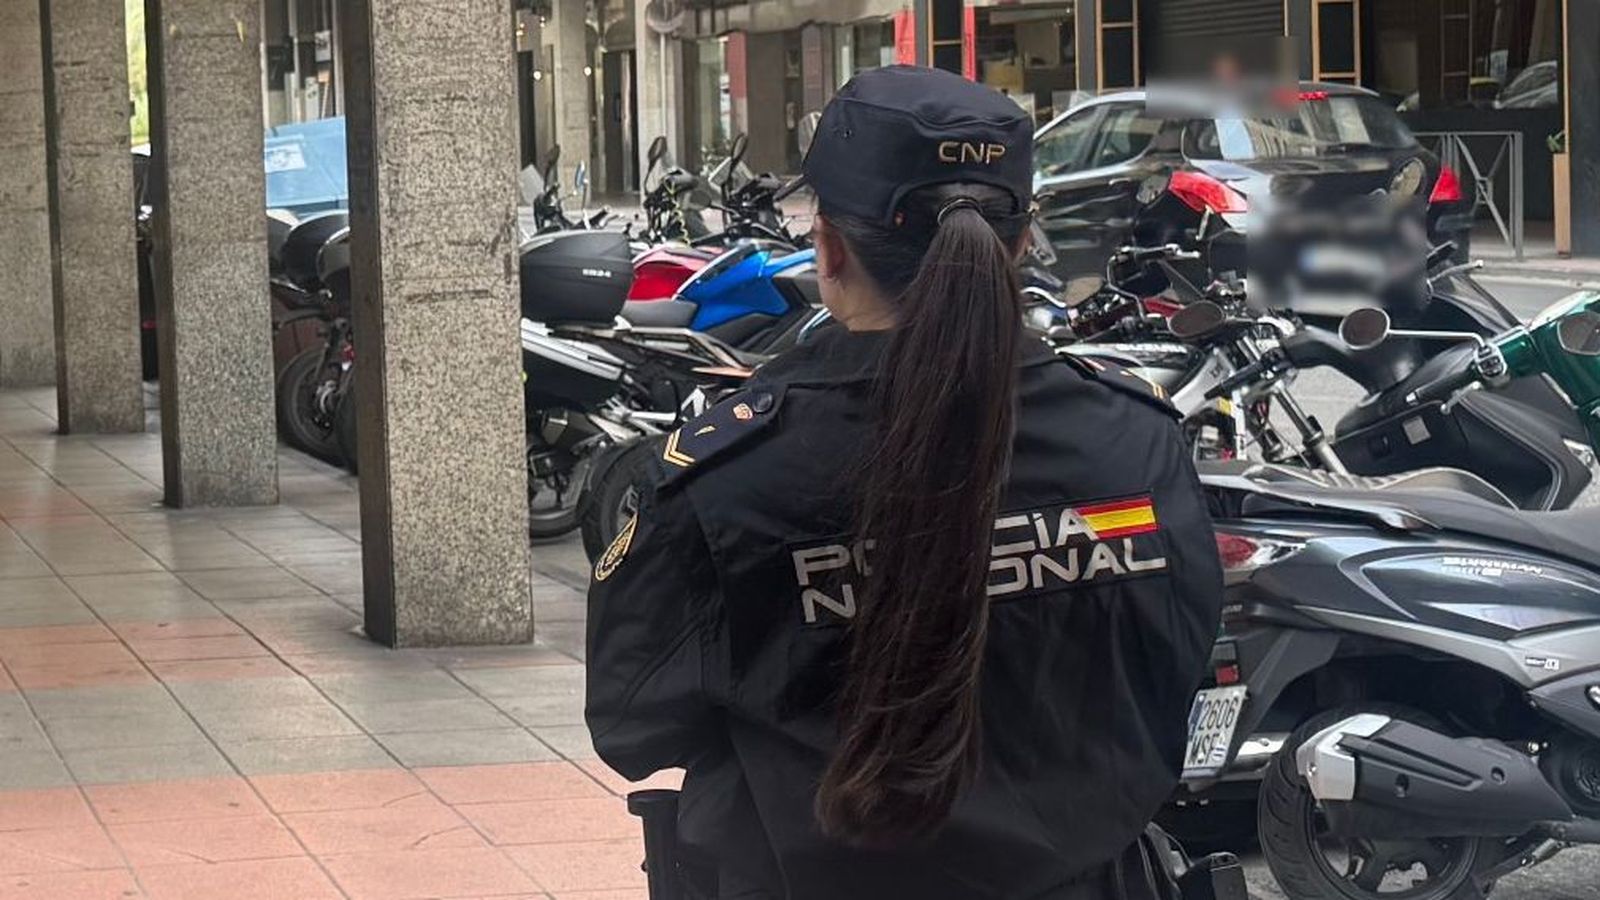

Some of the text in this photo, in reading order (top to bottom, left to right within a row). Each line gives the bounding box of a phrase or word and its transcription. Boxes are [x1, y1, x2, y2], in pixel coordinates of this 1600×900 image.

[939, 141, 1005, 164] CNP
[801, 538, 1166, 623] NONAL
[1197, 697, 1239, 731] 2606
